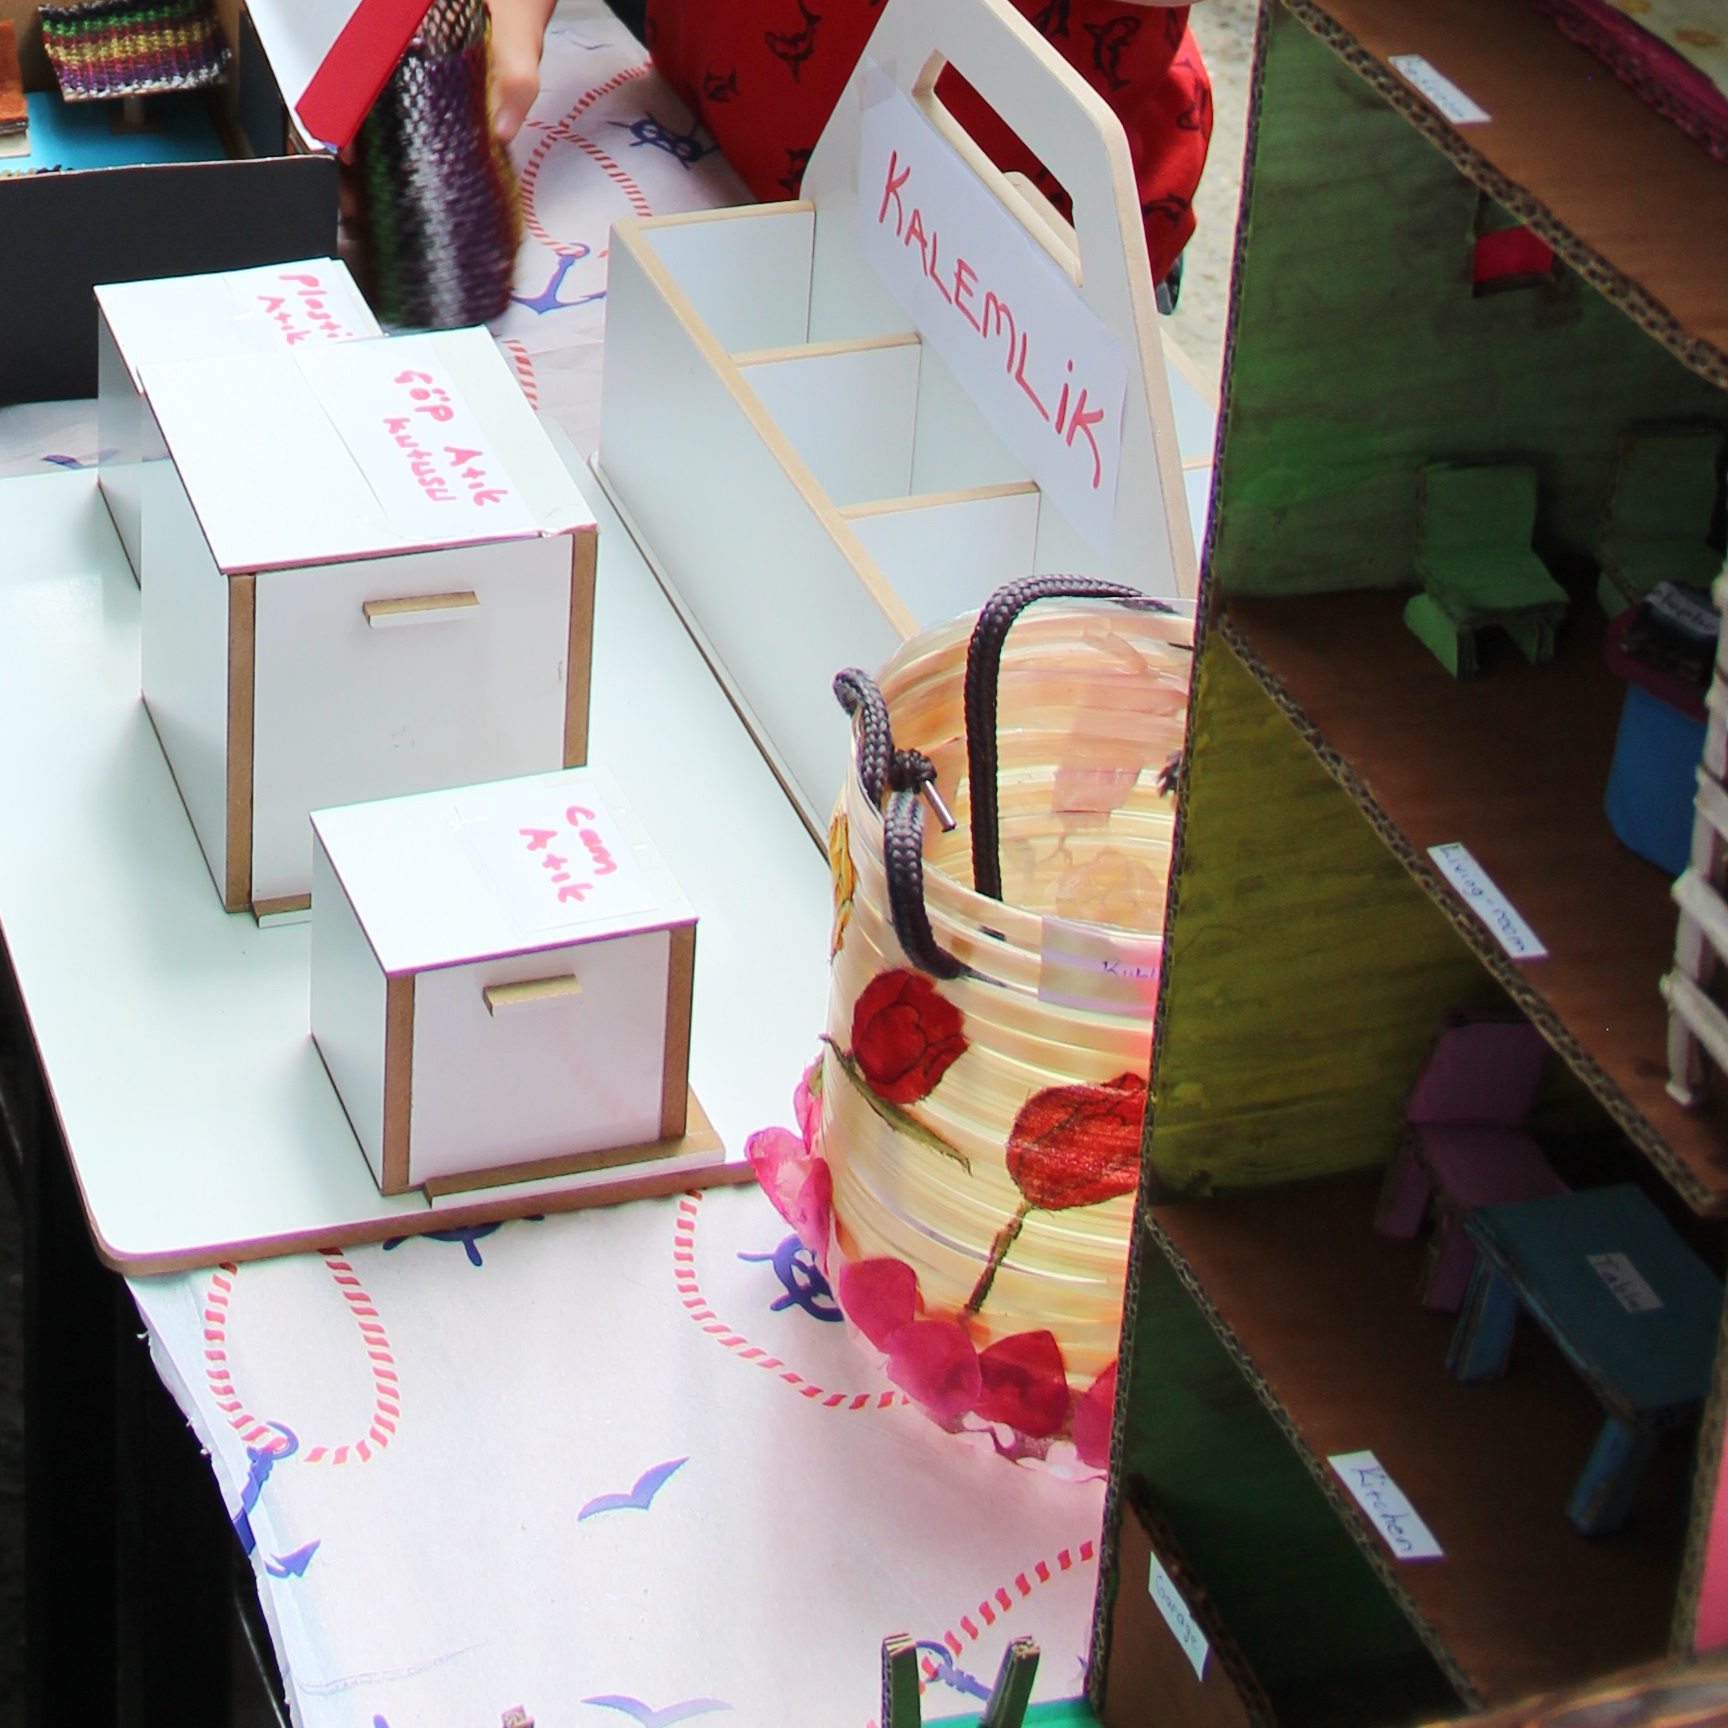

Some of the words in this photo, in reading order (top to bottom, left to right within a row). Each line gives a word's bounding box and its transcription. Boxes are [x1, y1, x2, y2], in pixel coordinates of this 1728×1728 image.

[277, 274, 354, 339] Plasti
[1350, 1466, 1413, 1552] Kitchen
[1154, 1574, 1198, 1651] Garage
